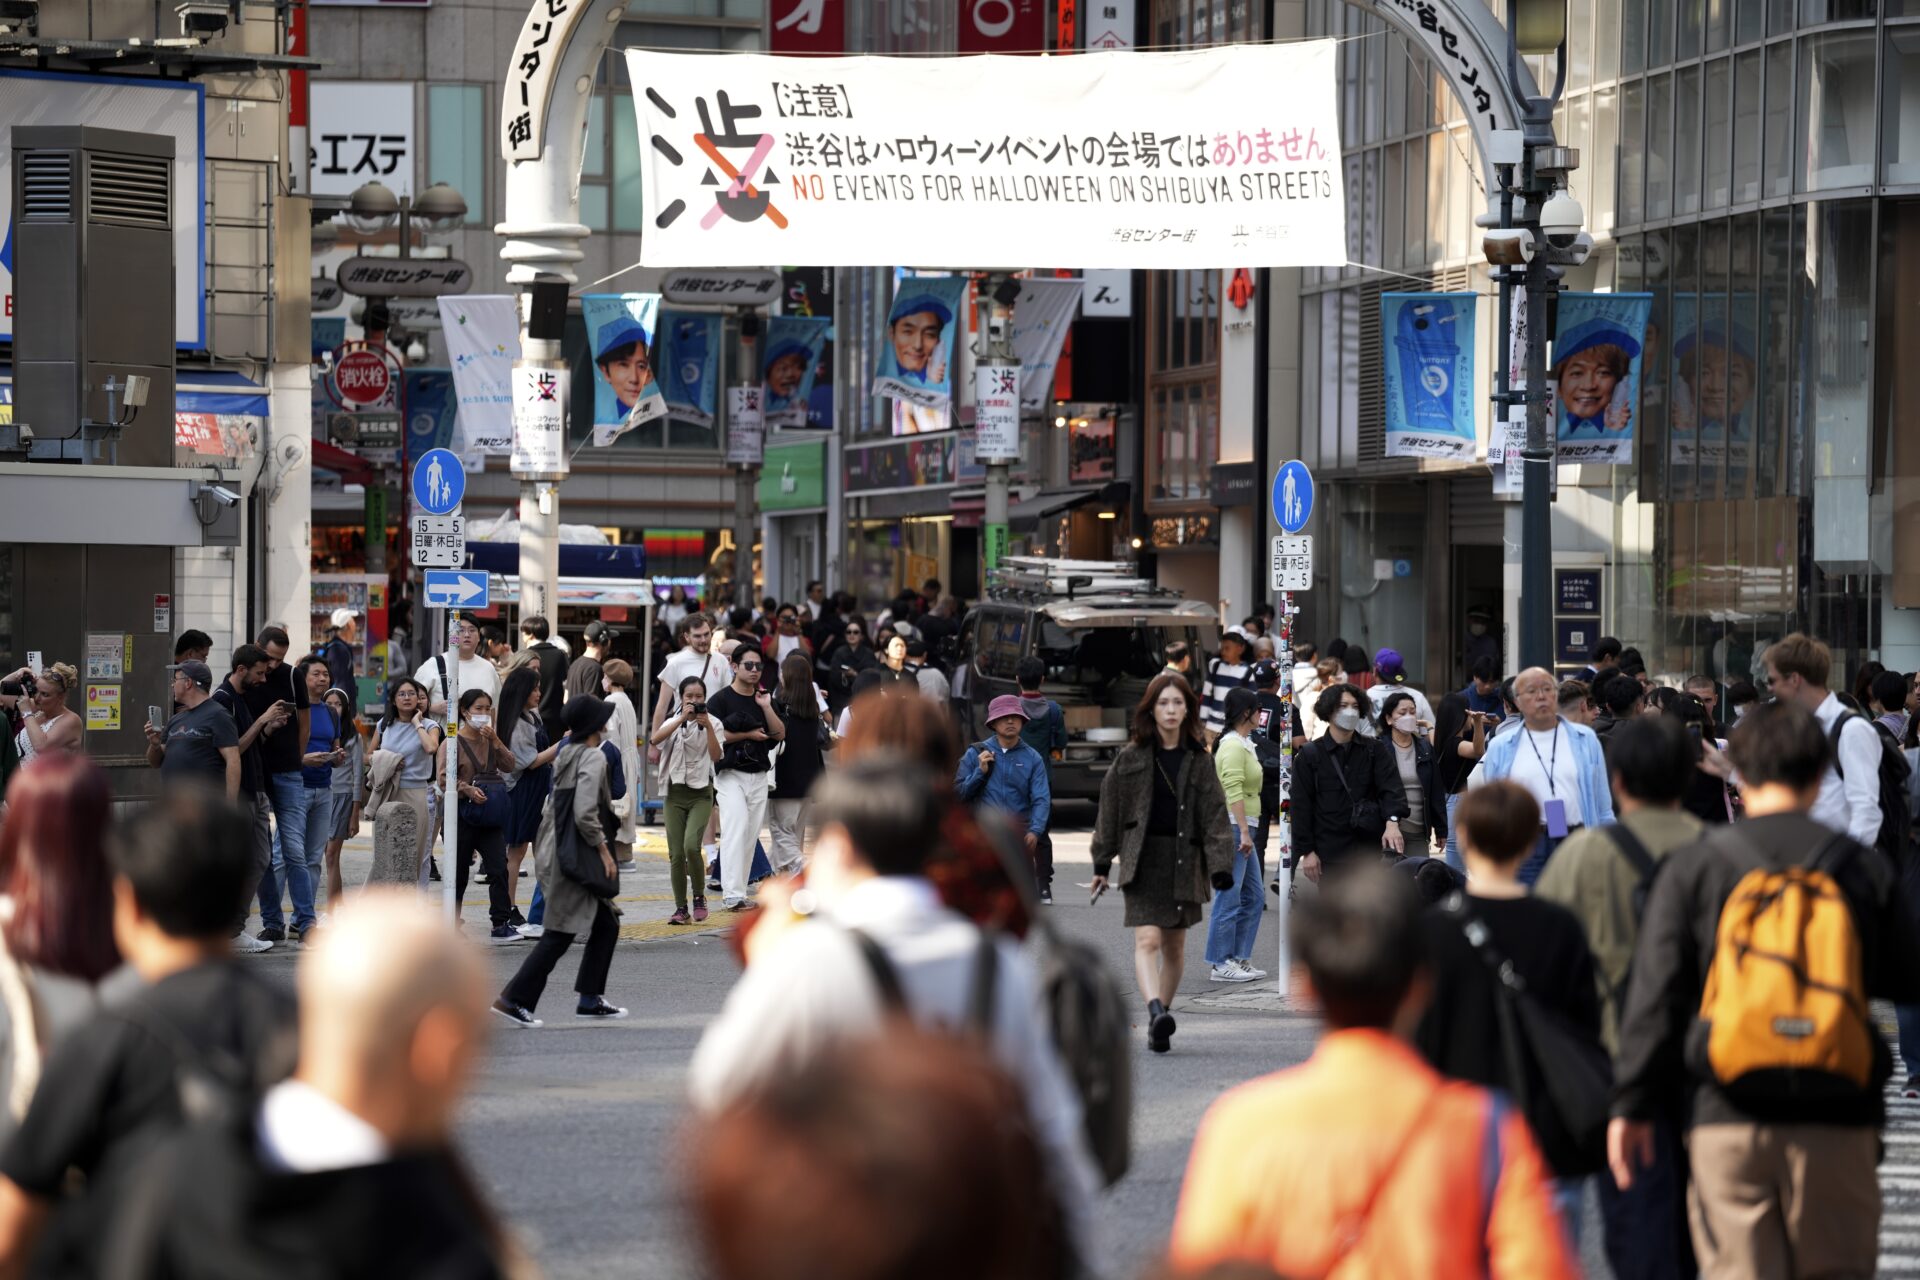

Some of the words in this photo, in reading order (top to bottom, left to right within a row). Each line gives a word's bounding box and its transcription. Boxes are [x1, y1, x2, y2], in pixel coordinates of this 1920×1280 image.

[771, 82, 854, 119] 【注意】
[792, 174, 825, 201] NO
[833, 174, 915, 201] EVENTS
[923, 175, 964, 201] FOR
[973, 174, 1102, 202] HALLOWEEN
[1109, 176, 1136, 202] ON
[1140, 175, 1234, 204] SHIBUYA
[1240, 170, 1332, 200] STREETS
[340, 366, 385, 389] 消火栓
[418, 520, 428, 533] 15
[453, 520, 459, 533] 5
[415, 535, 463, 548] 日曜・休日は
[1276, 540, 1284, 554] 15
[1302, 540, 1308, 553] 5
[418, 550, 428, 563] 12
[452, 550, 459, 563] 5
[1274, 556, 1310, 571] 日曜・休日は
[1276, 574, 1284, 588] 12
[1302, 573, 1308, 587] 5
